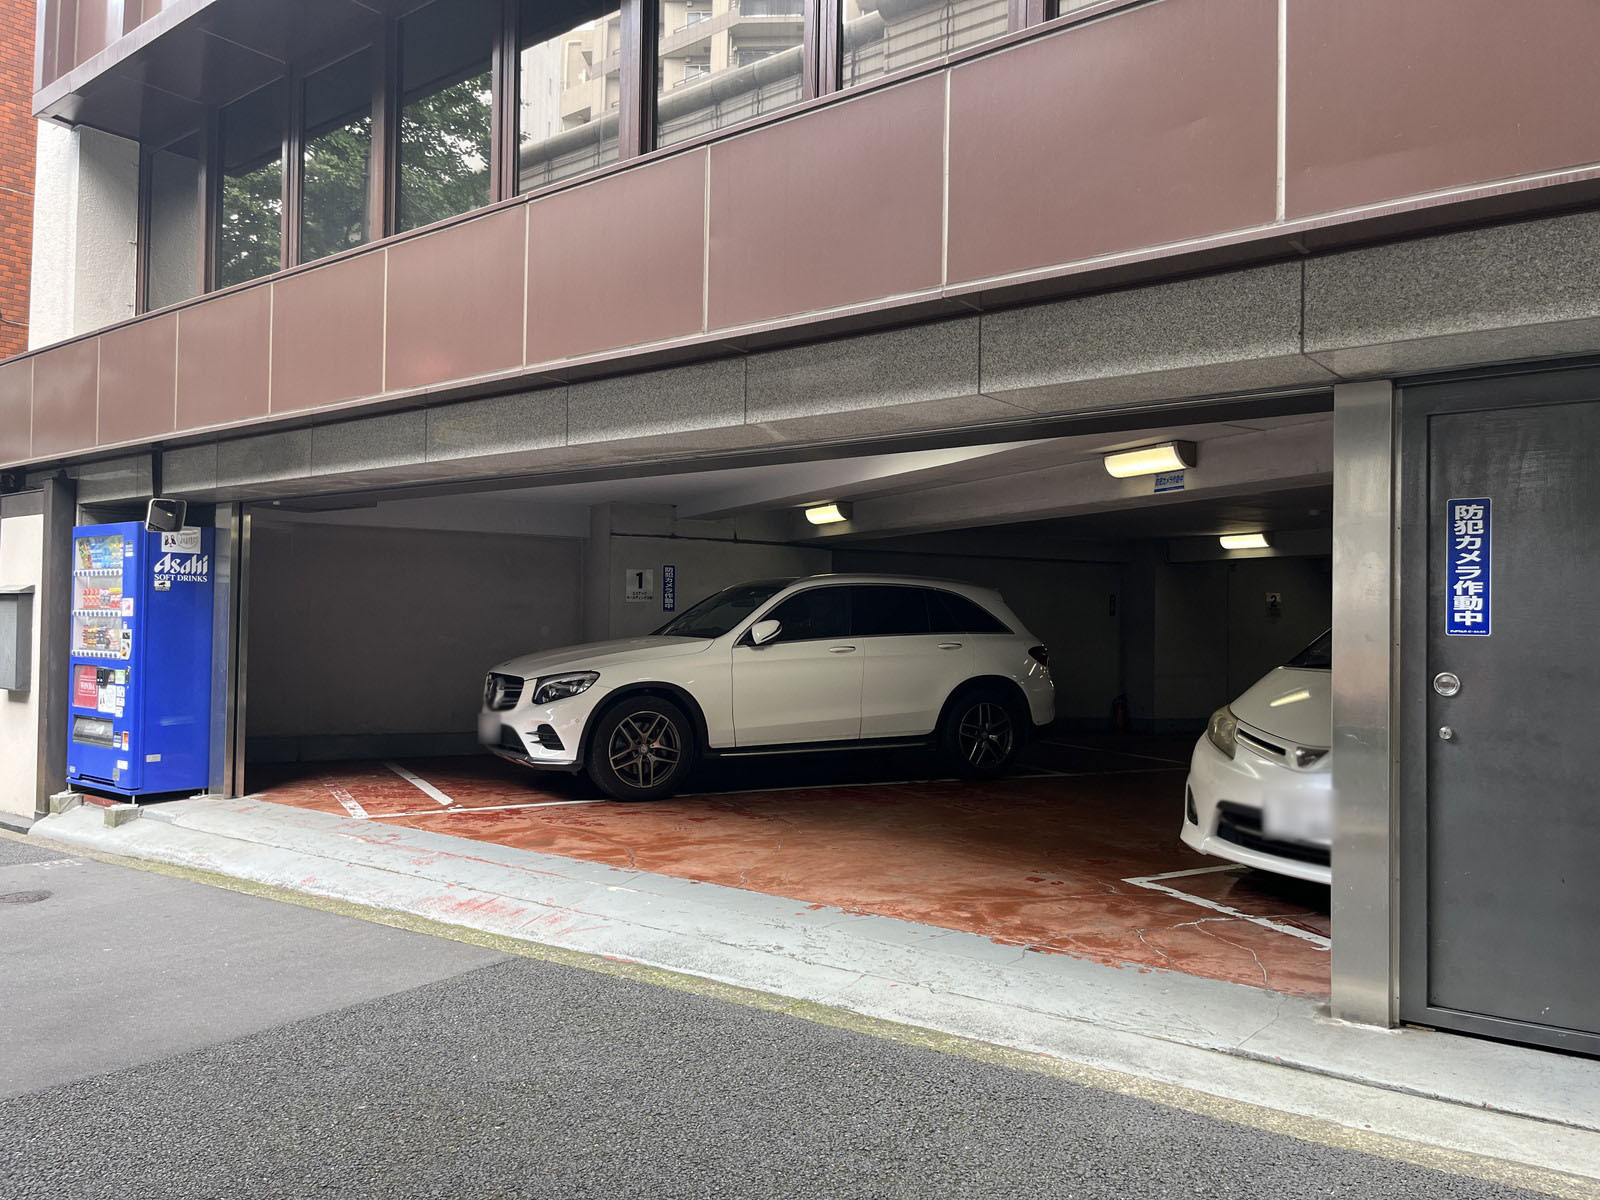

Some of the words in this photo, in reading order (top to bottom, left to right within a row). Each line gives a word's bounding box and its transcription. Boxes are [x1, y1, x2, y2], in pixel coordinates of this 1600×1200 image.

[154, 553, 208, 575] Asahi
[1453, 505, 1485, 626] 防犯カメラ作動中
[177, 574, 208, 583] DRINKS
[636, 572, 643, 589] 1
[1270, 595, 1277, 608] 2
